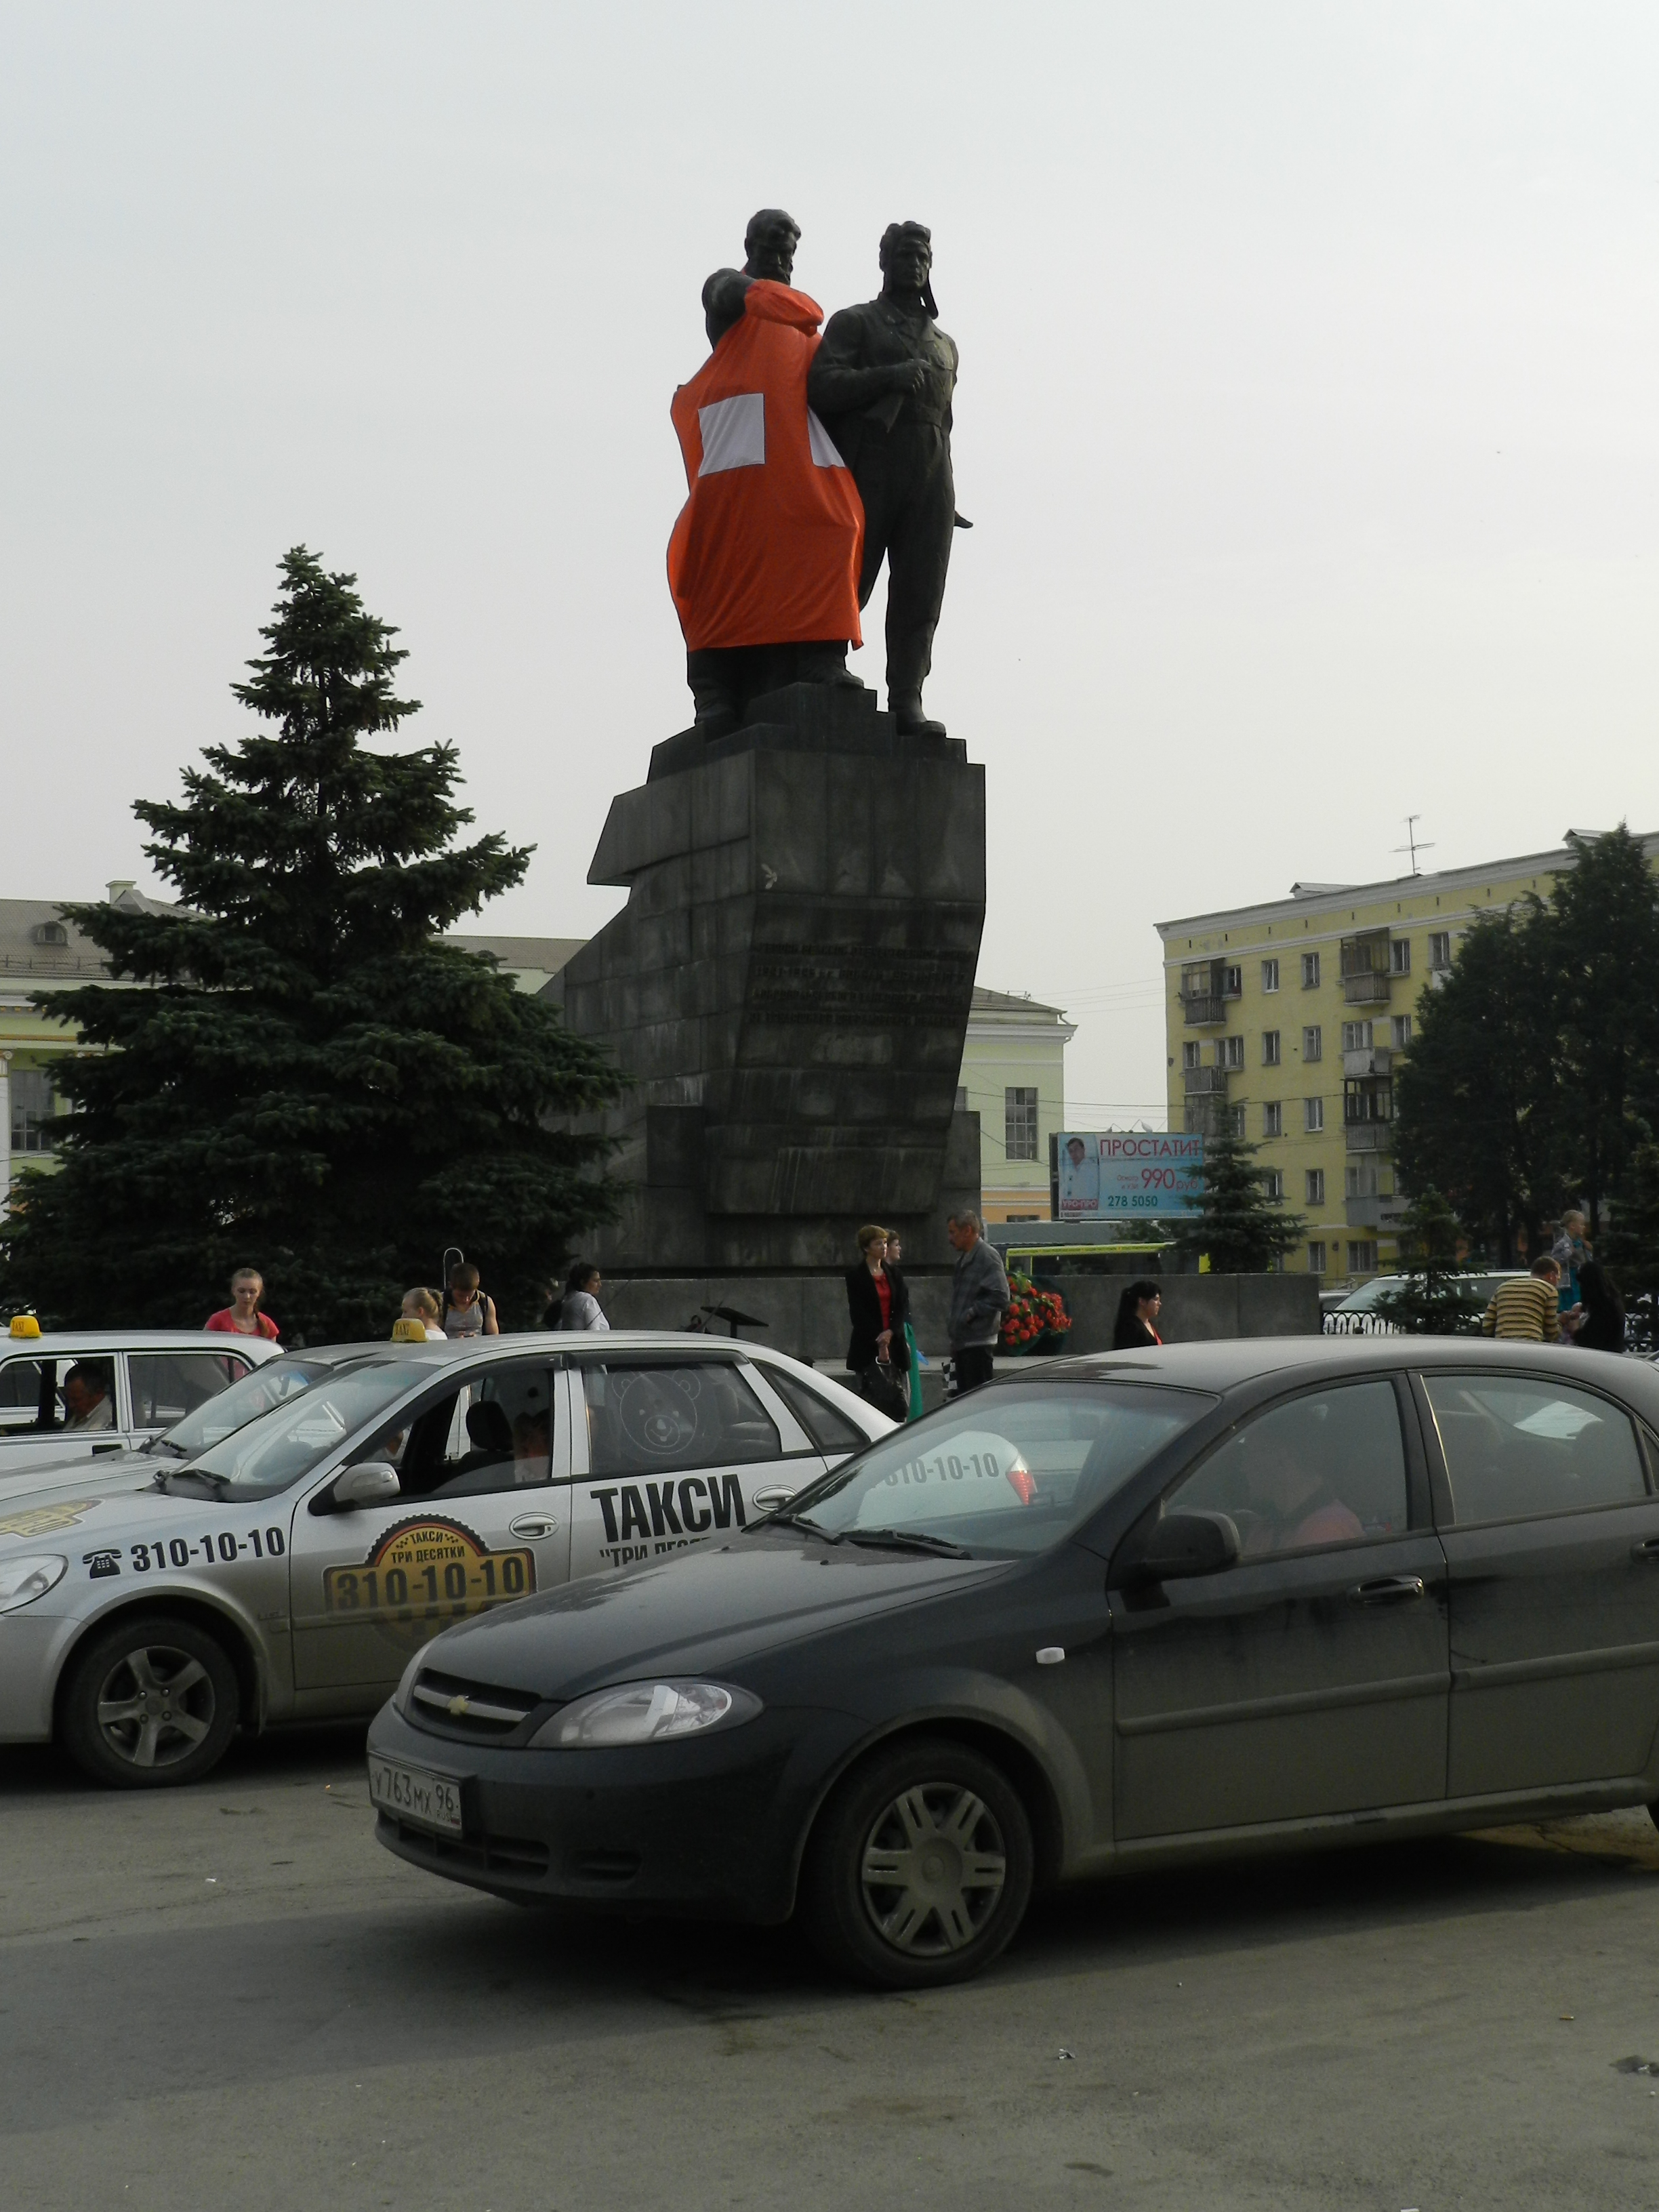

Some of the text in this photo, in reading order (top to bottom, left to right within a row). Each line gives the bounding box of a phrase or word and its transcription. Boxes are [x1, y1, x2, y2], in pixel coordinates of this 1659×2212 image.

[1100, 1139, 1200, 1156] ПРОСТАТИТ
[1141, 1168, 1175, 1189] 990
[1108, 1195, 1158, 1206] 278 5050
[590, 1473, 746, 1543] ТАКСИ
[409, 1530, 444, 1544] ТАКСИ
[130, 1526, 285, 1572] 310-10-10
[391, 1545, 466, 1563] ТРИ ДЕСЯТКИ
[337, 1556, 525, 1611] 310-10-10
